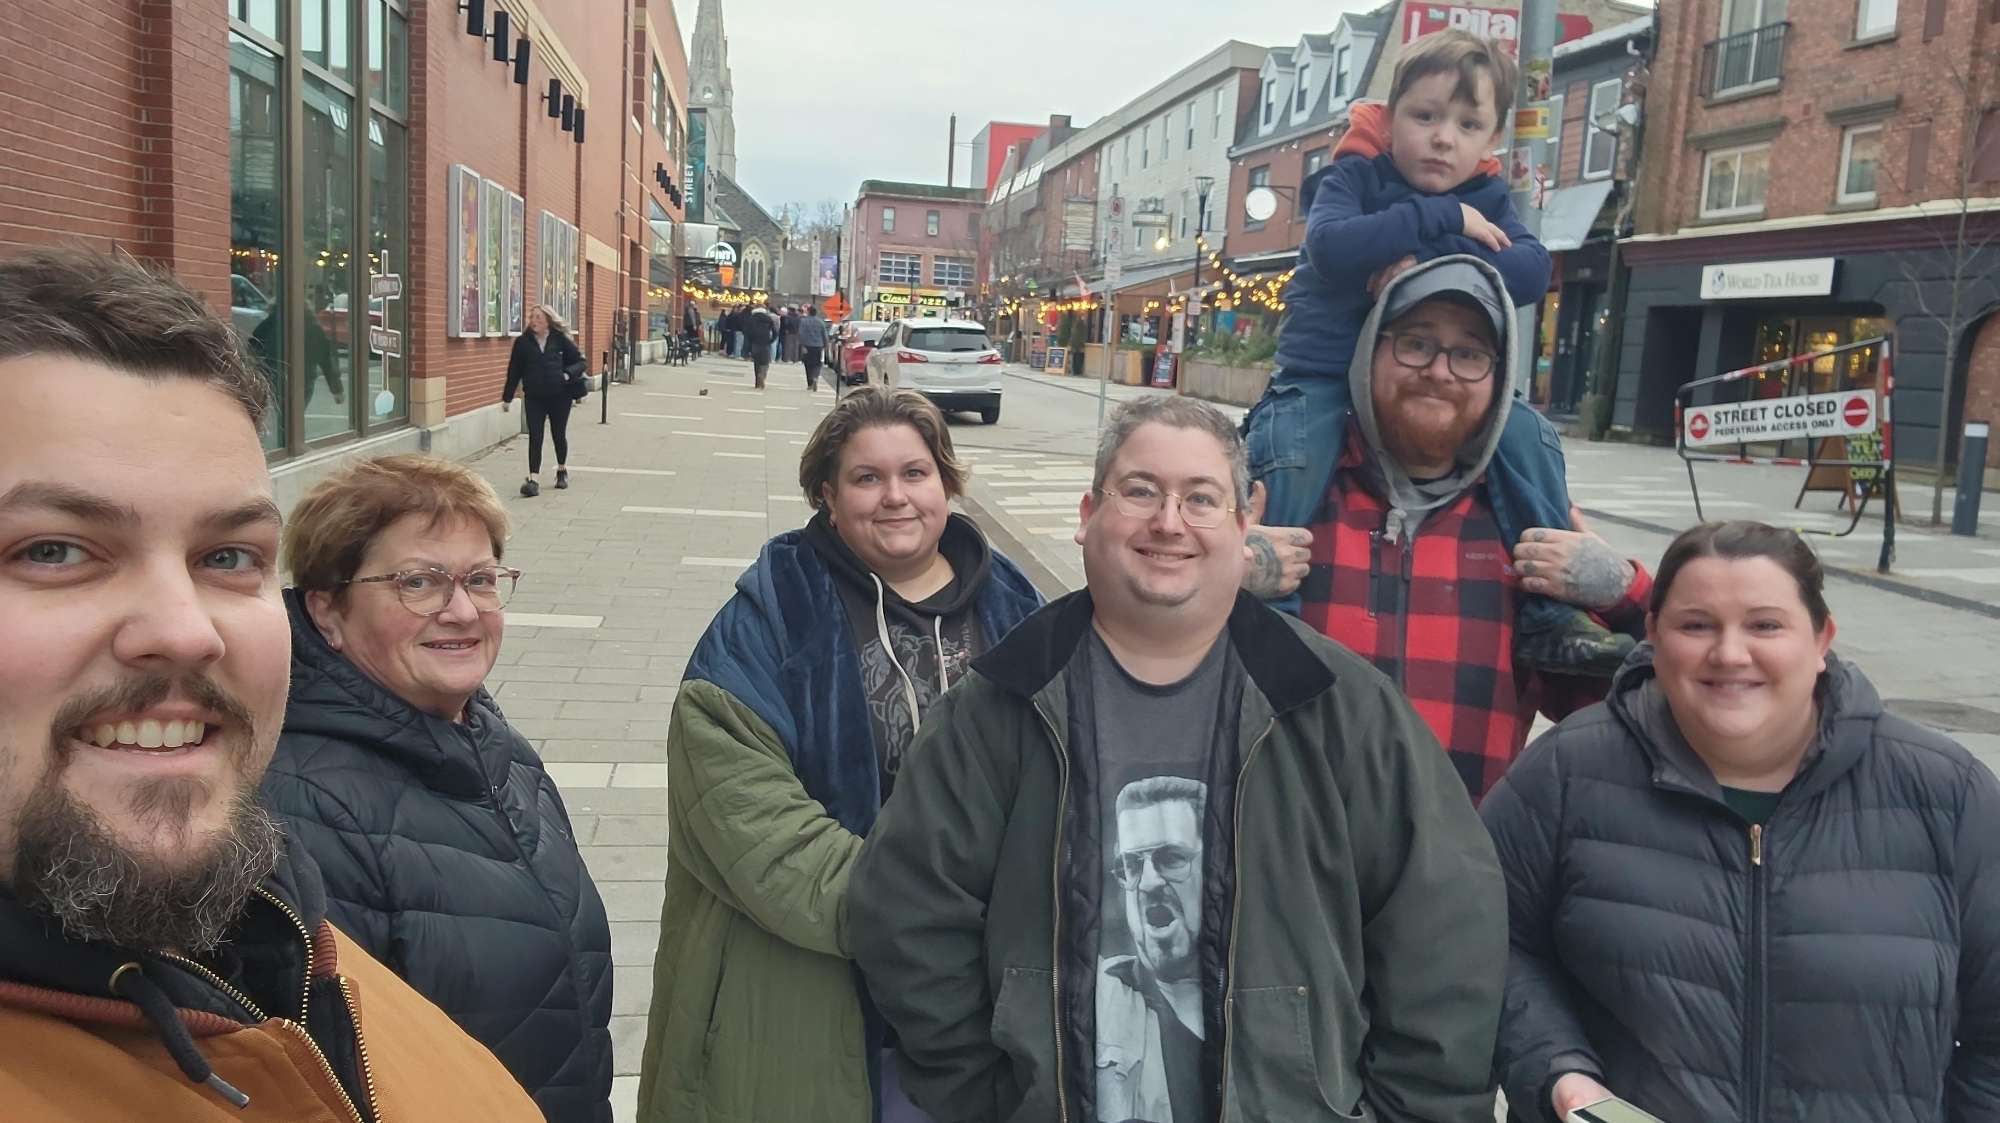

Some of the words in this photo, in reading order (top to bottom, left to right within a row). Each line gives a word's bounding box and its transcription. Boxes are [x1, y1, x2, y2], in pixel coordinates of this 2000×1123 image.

[1726, 274, 1762, 290] WORLD
[1763, 273, 1782, 288] TEA
[1784, 272, 1820, 287] HOUSE
[1714, 408, 1768, 424] STREET
[1774, 400, 1837, 418] CLOSED
[1714, 424, 1767, 436] PEDESTRIAN
[1770, 421, 1808, 433] ACCESS
[1811, 418, 1836, 429] ONLY
